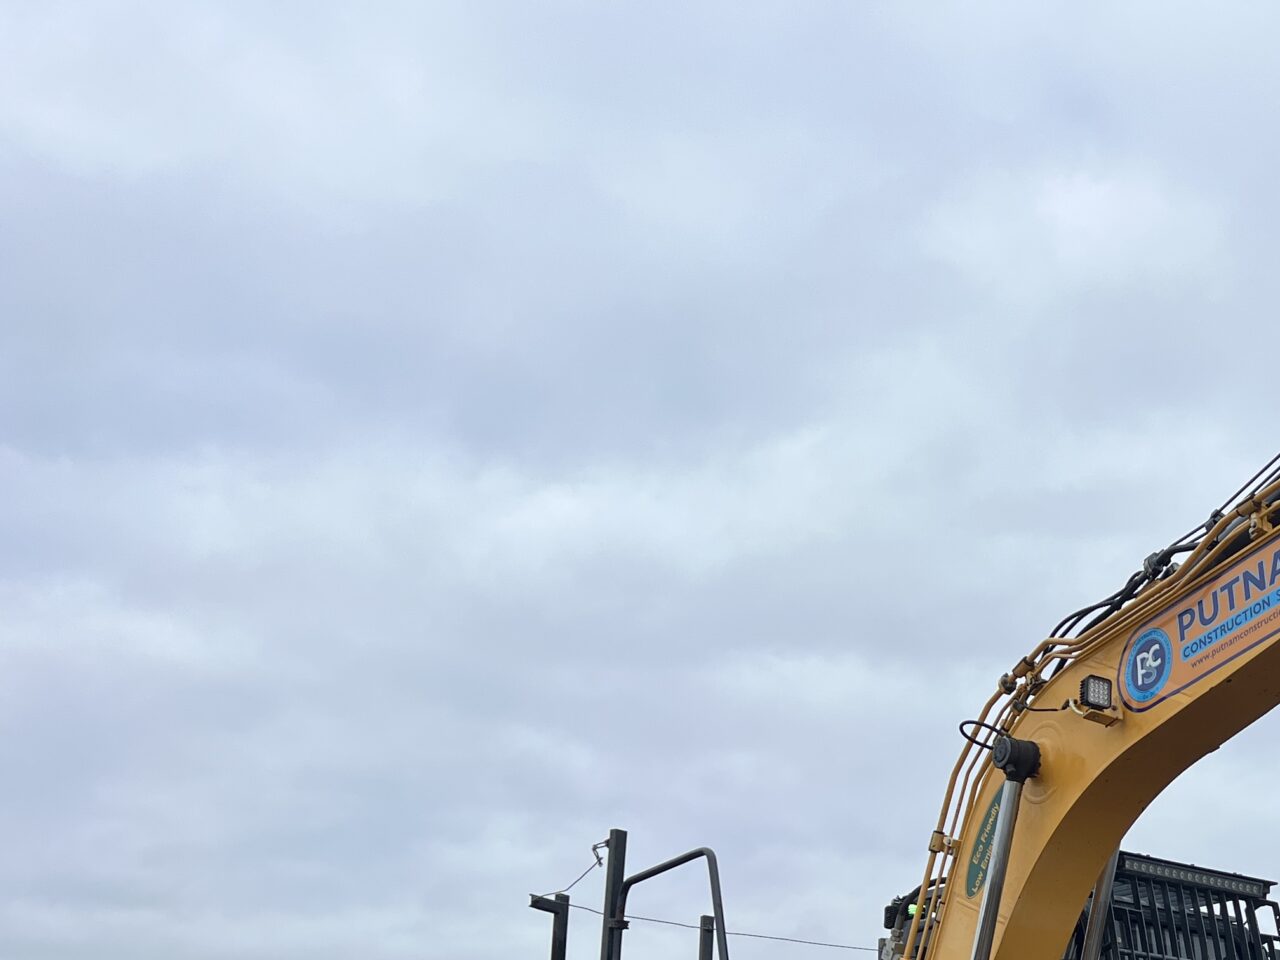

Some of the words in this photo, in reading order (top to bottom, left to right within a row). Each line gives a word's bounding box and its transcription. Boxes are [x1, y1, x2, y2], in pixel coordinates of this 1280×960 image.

[1183, 597, 1271, 658] CONSTRUCTION
[972, 844, 984, 865] Eco
[980, 803, 1000, 843] Friendly
[972, 872, 984, 893] Low
